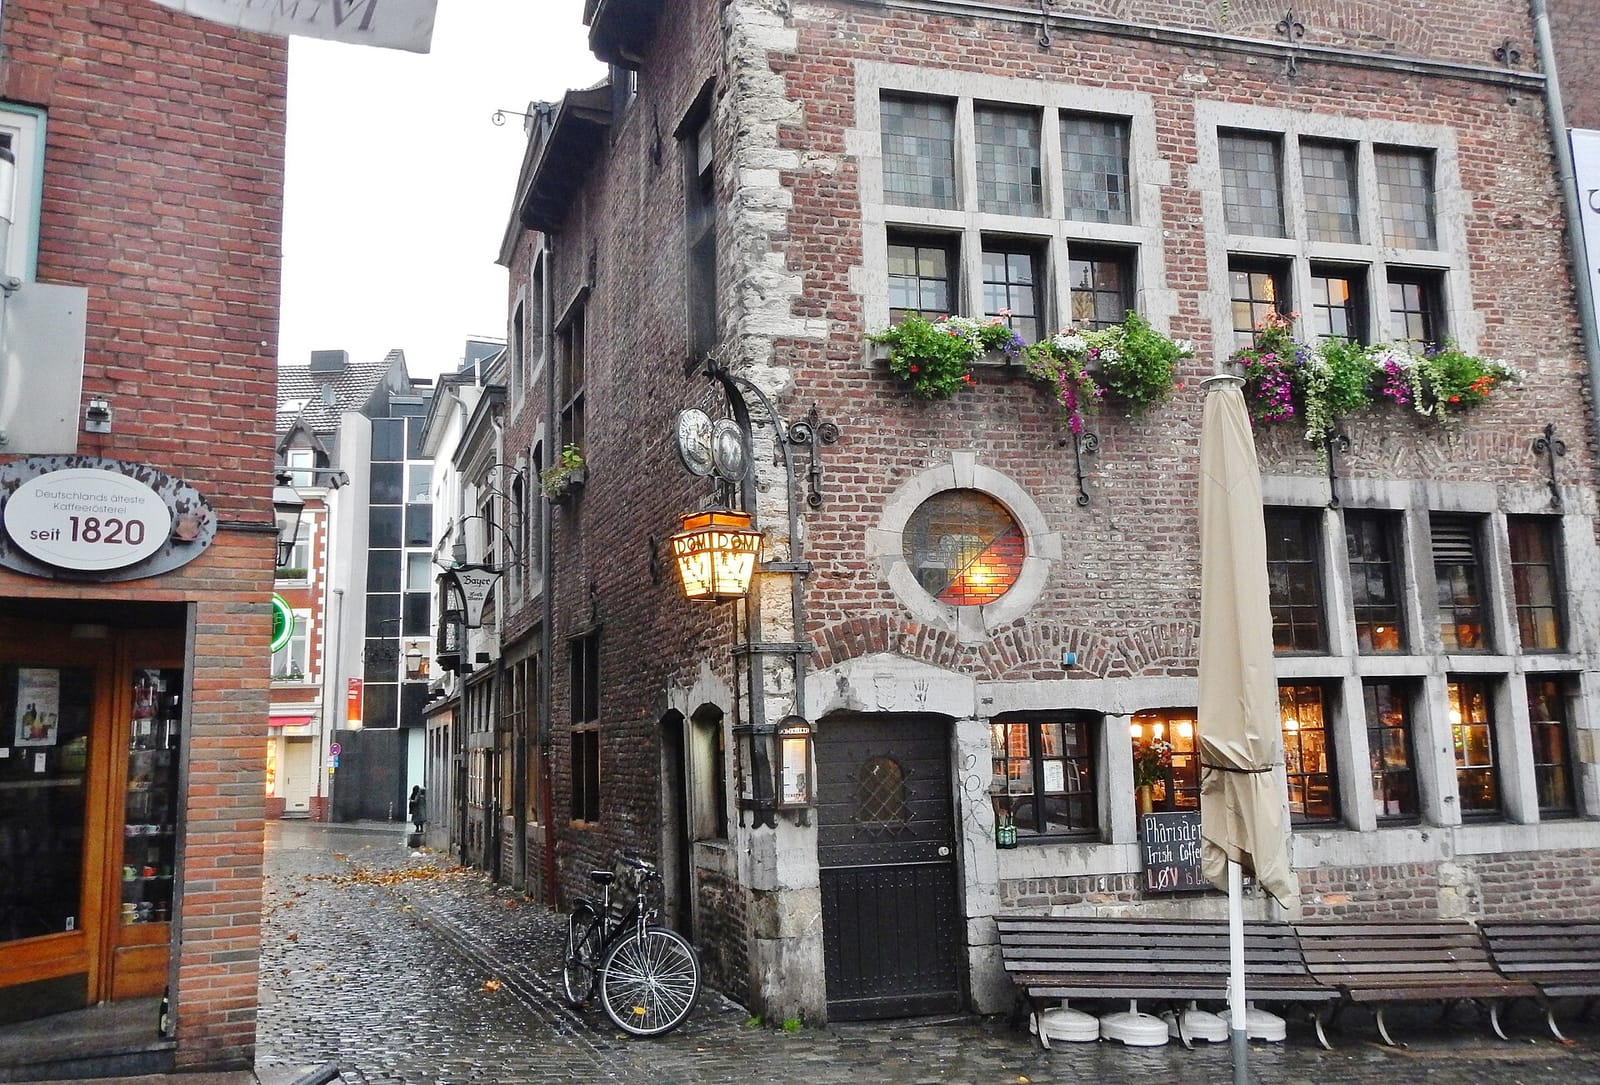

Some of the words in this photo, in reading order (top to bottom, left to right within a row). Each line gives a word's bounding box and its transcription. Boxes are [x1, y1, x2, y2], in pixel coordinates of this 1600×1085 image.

[35, 488, 108, 503] Deutschlands
[110, 493, 145, 504] älteste
[53, 502, 127, 514] Kaffeerösterei
[30, 527, 61, 541] seit
[69, 516, 145, 545] 1820
[677, 533, 706, 554] DOM
[718, 534, 755, 551] DOM
[1147, 844, 1173, 865] Irish
[1179, 841, 1202, 866] Coffe
[1185, 868, 1193, 885] is
